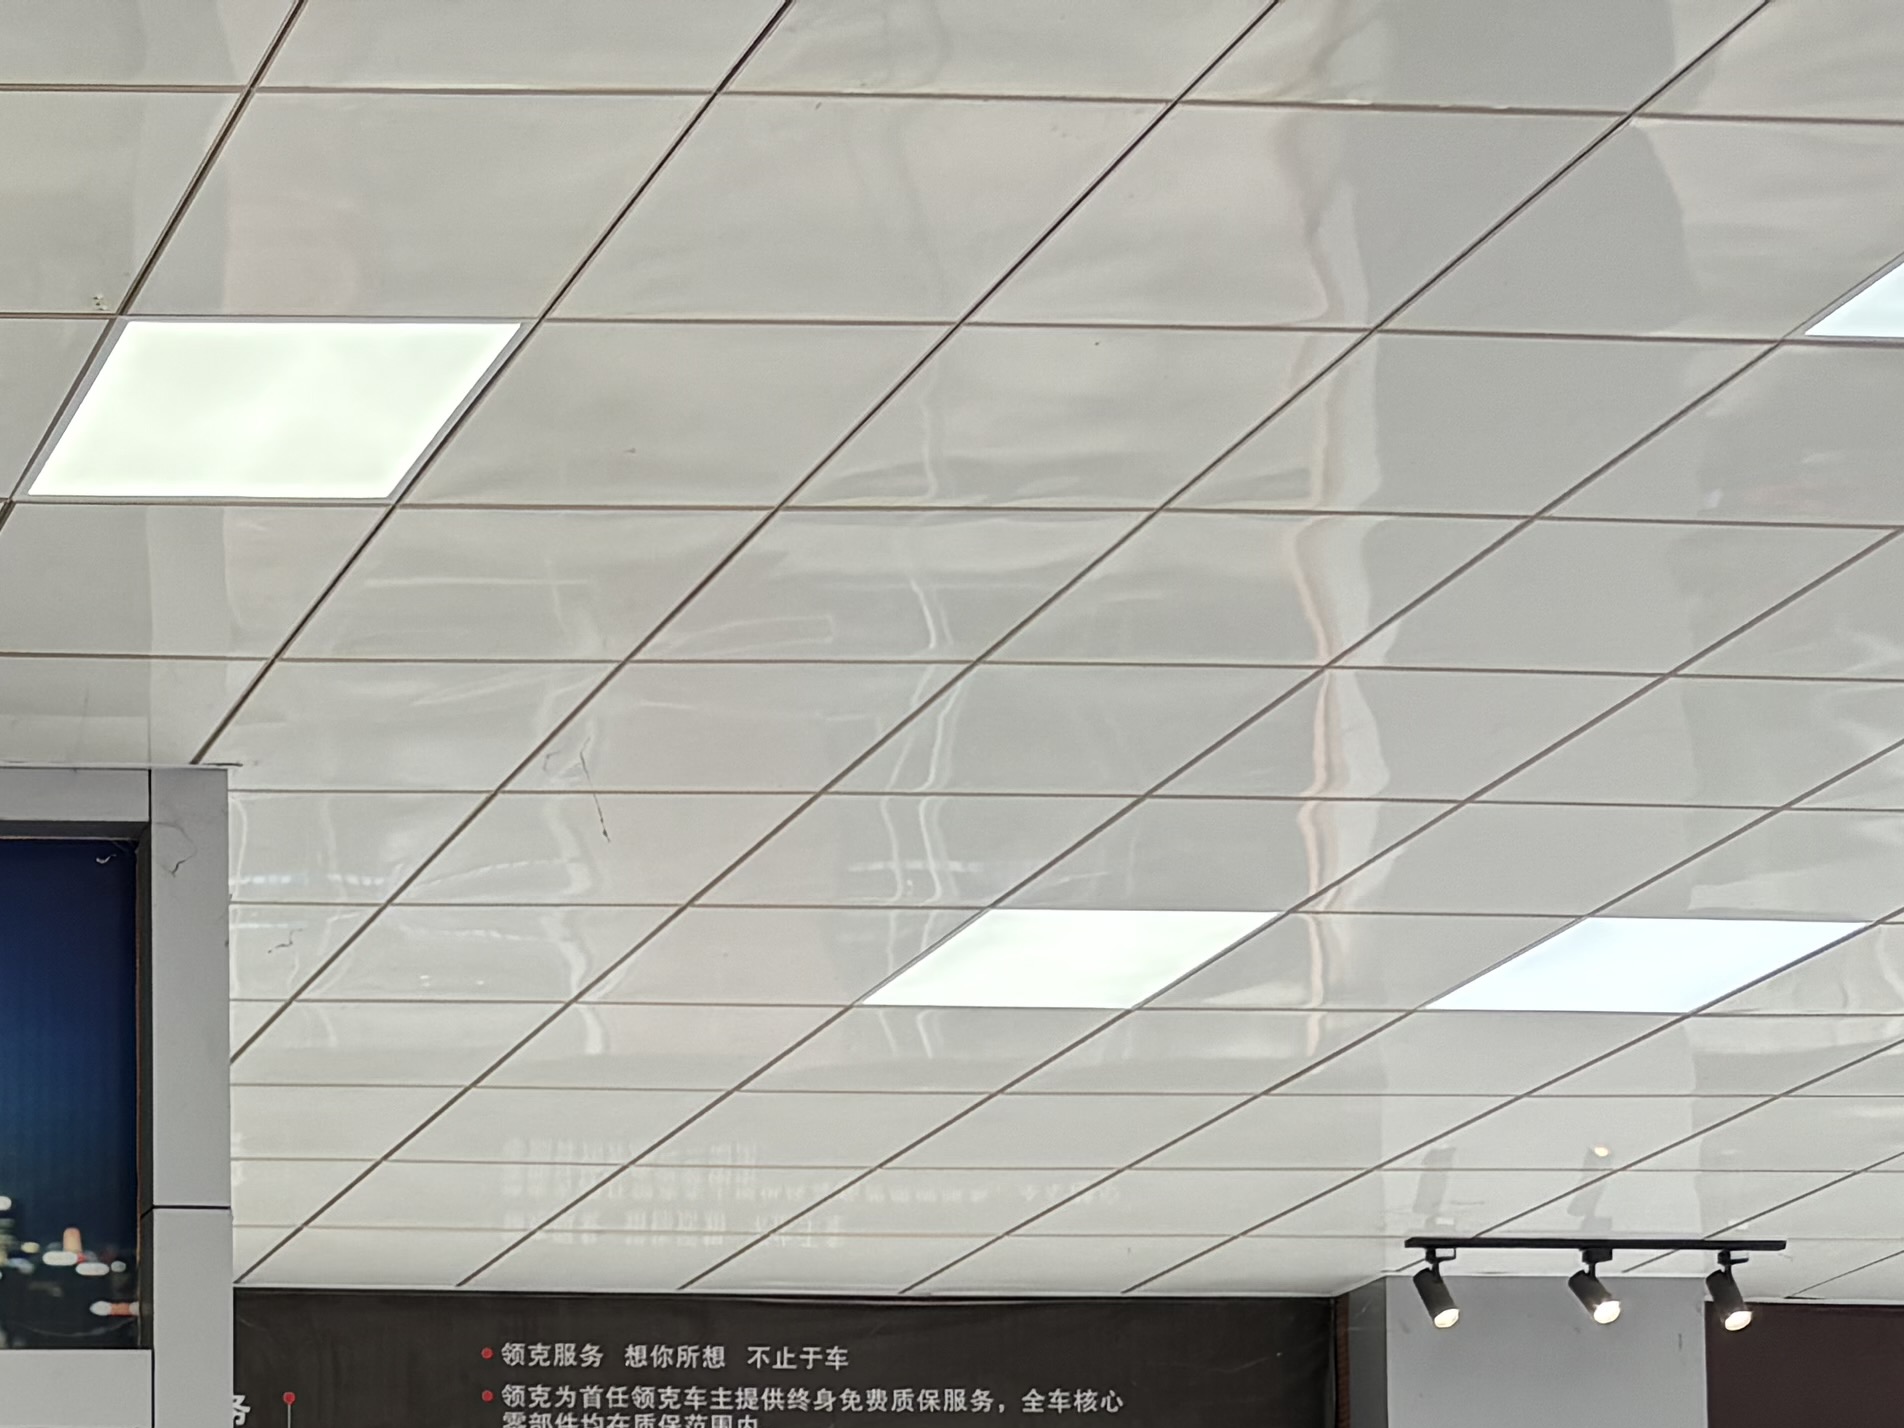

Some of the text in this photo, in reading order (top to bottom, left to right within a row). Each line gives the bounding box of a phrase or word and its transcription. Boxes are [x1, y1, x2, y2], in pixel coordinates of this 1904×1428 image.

[501, 1342, 851, 1371] 领克服务 想你所想 不止于车
